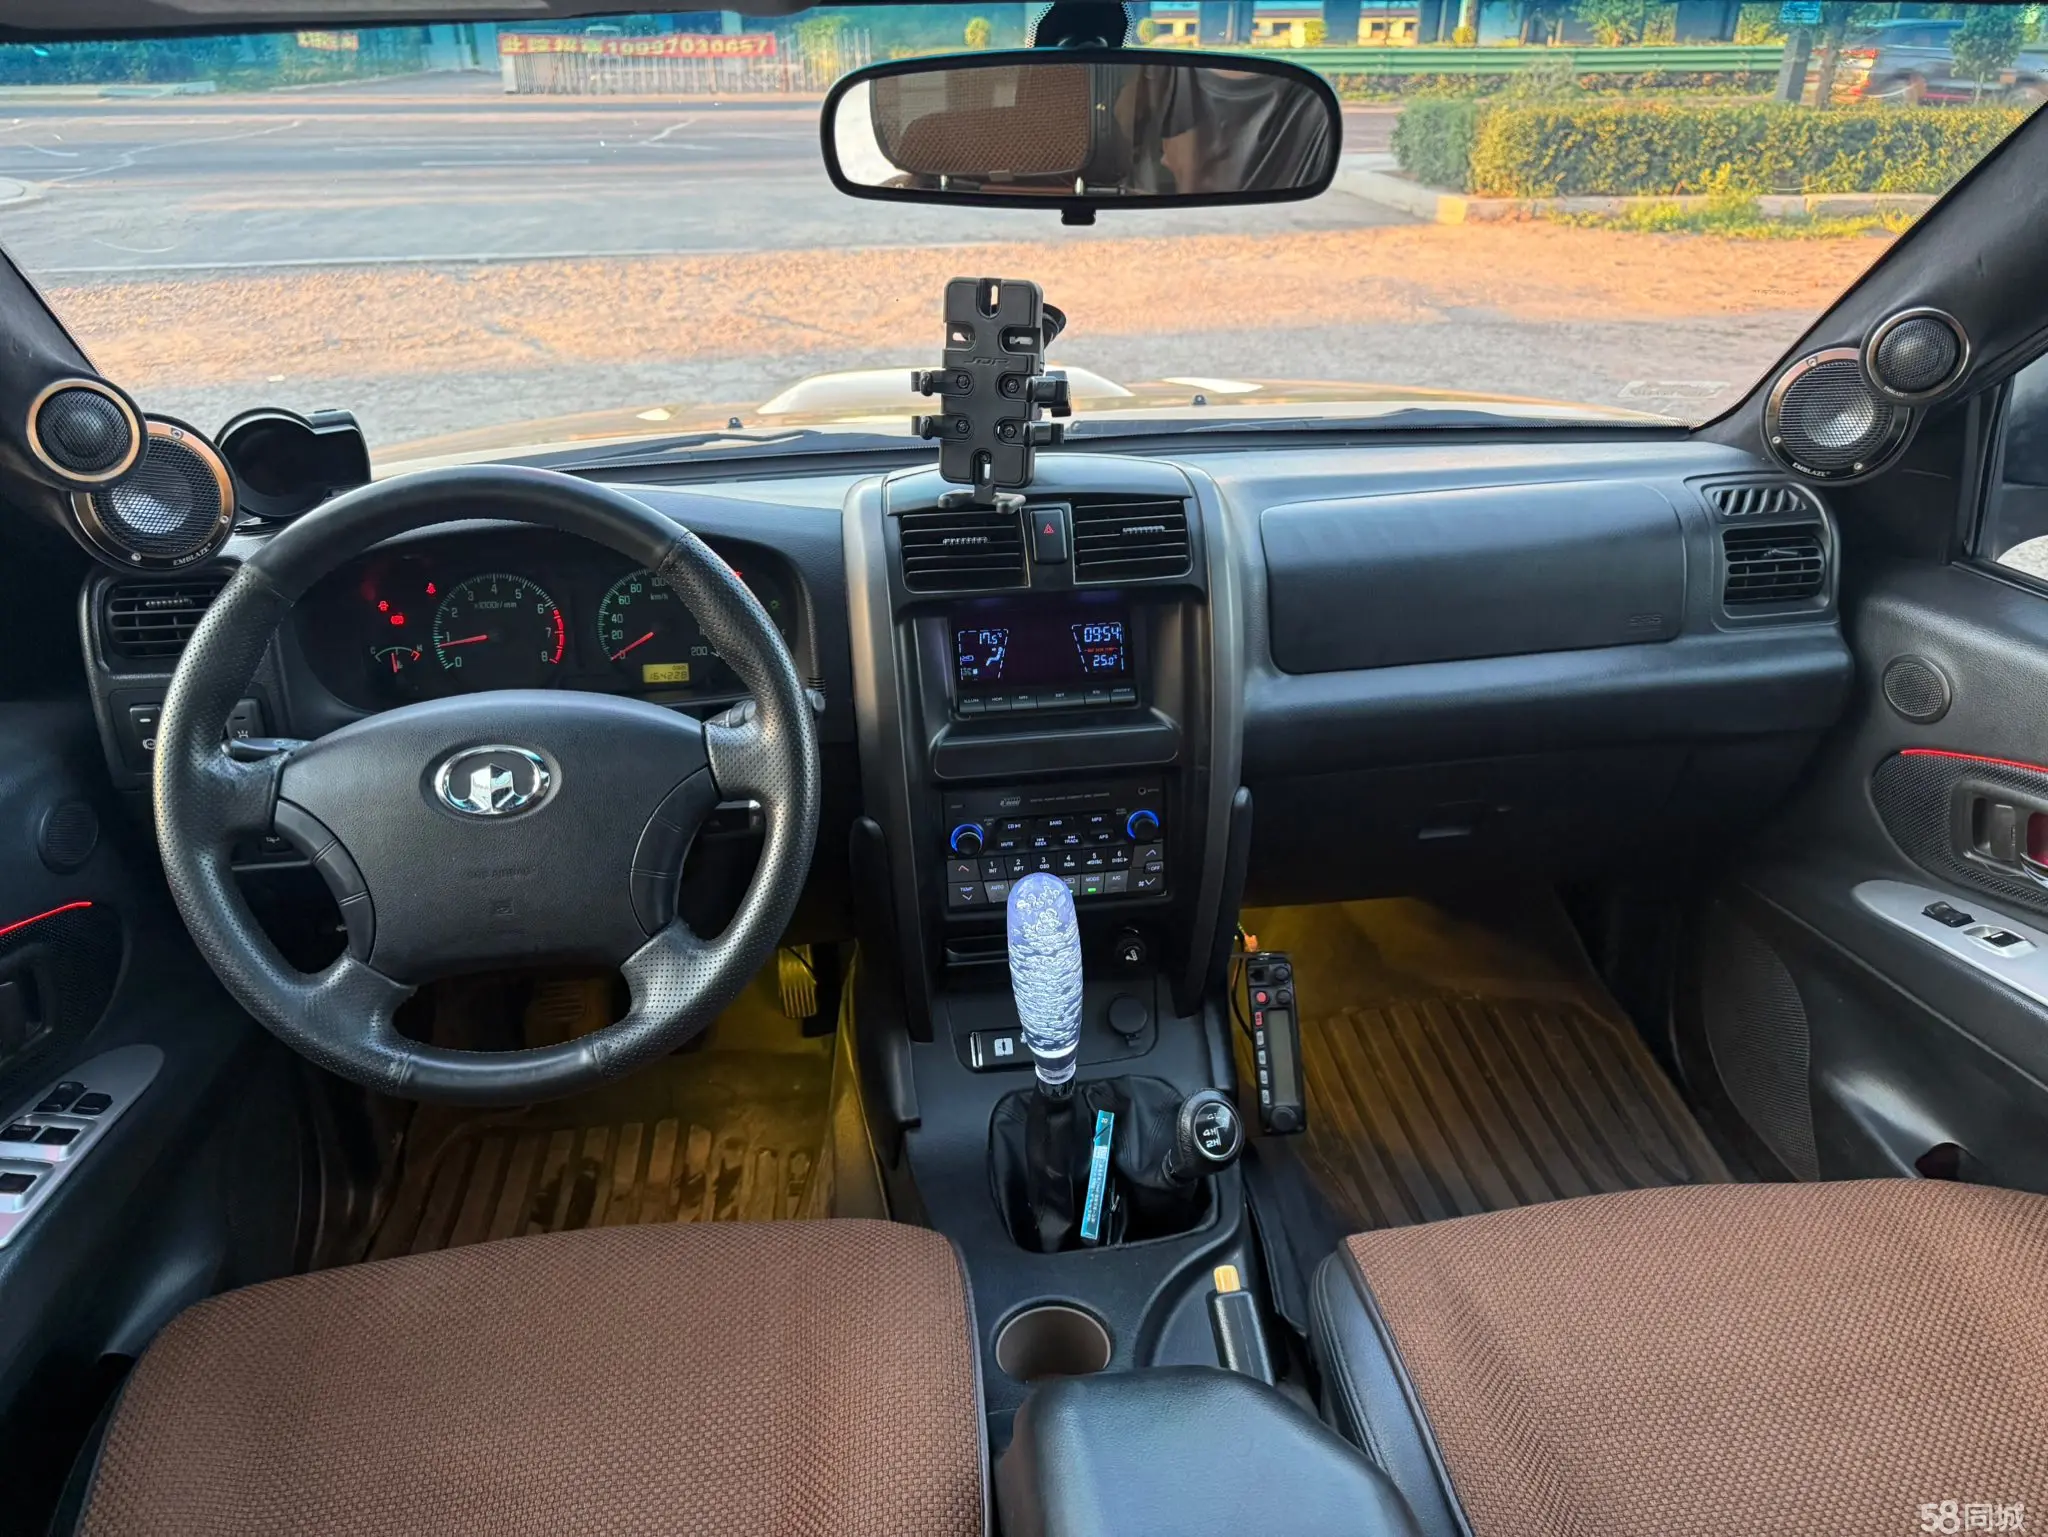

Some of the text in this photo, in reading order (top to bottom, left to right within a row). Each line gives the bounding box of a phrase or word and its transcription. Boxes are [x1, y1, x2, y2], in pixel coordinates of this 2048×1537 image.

[491, 583, 498, 595] 4
[514, 588, 522, 600] 5
[467, 590, 475, 602] 3
[618, 595, 631, 605] 60
[451, 607, 459, 618] 2
[537, 603, 545, 614] 6
[611, 613, 624, 624] 40
[545, 626, 552, 638] 7
[611, 629, 624, 640] 20
[541, 651, 548, 662] 8
[690, 646, 708, 656] 200
[454, 656, 463, 668] 0
